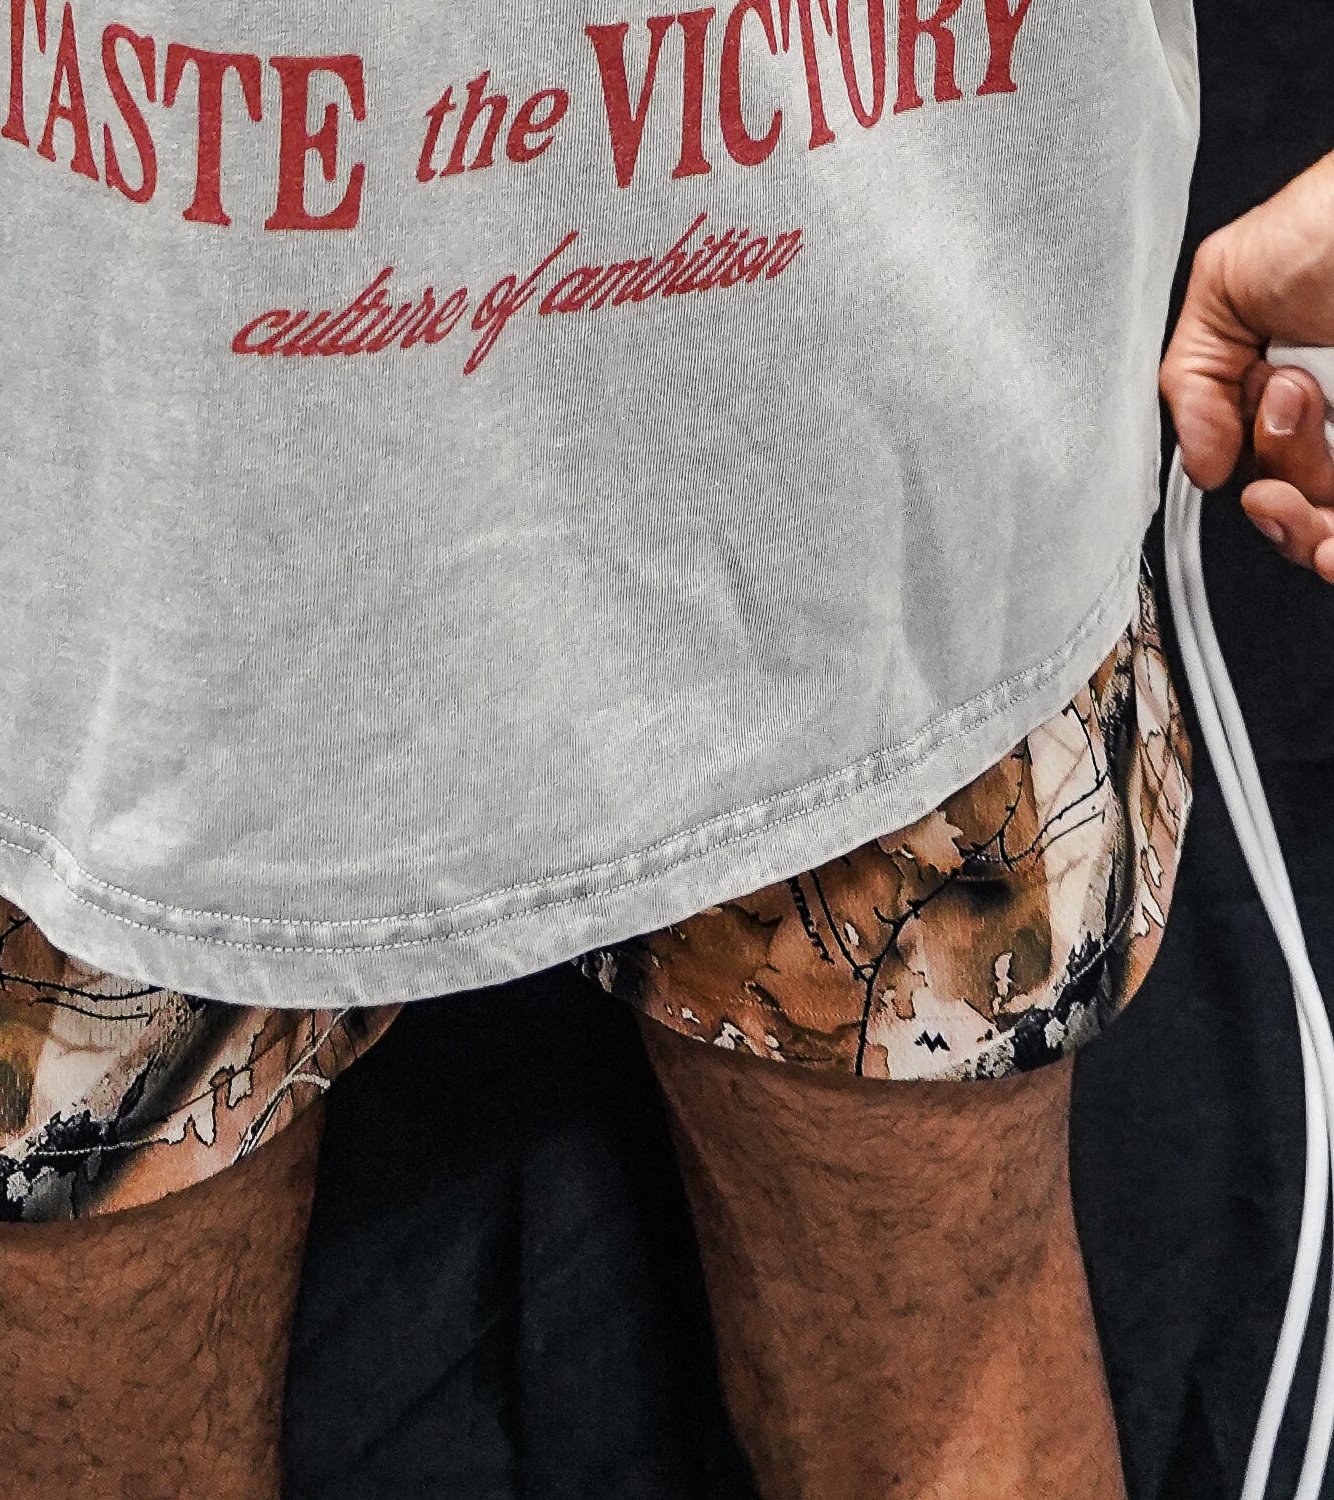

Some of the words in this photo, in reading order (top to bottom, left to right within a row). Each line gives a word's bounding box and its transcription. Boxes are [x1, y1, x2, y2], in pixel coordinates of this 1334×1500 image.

[416, 70, 570, 184] the
[230, 266, 467, 357] culture
[463, 230, 579, 375] of
[538, 212, 803, 316] ambition
